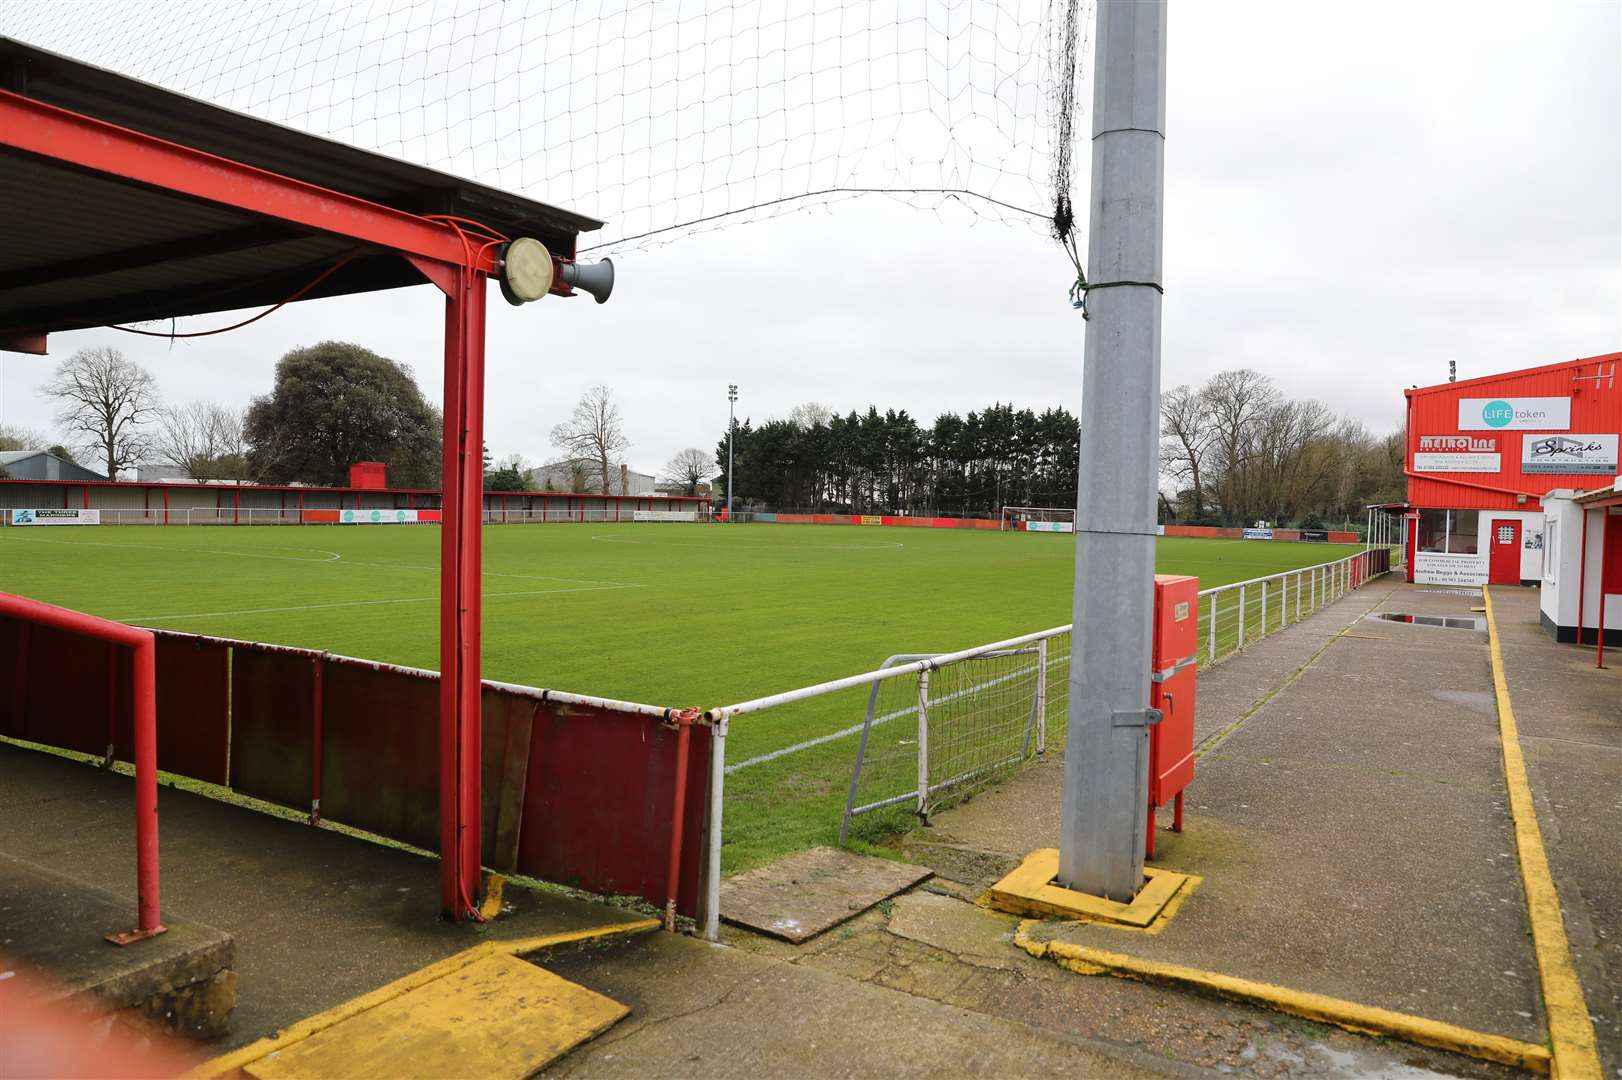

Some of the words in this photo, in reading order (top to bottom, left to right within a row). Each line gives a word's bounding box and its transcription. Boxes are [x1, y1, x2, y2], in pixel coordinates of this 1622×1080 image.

[1484, 409, 1512, 419] LIFE
[1515, 409, 1546, 419] token
[1535, 439, 1602, 457] Sprinks
